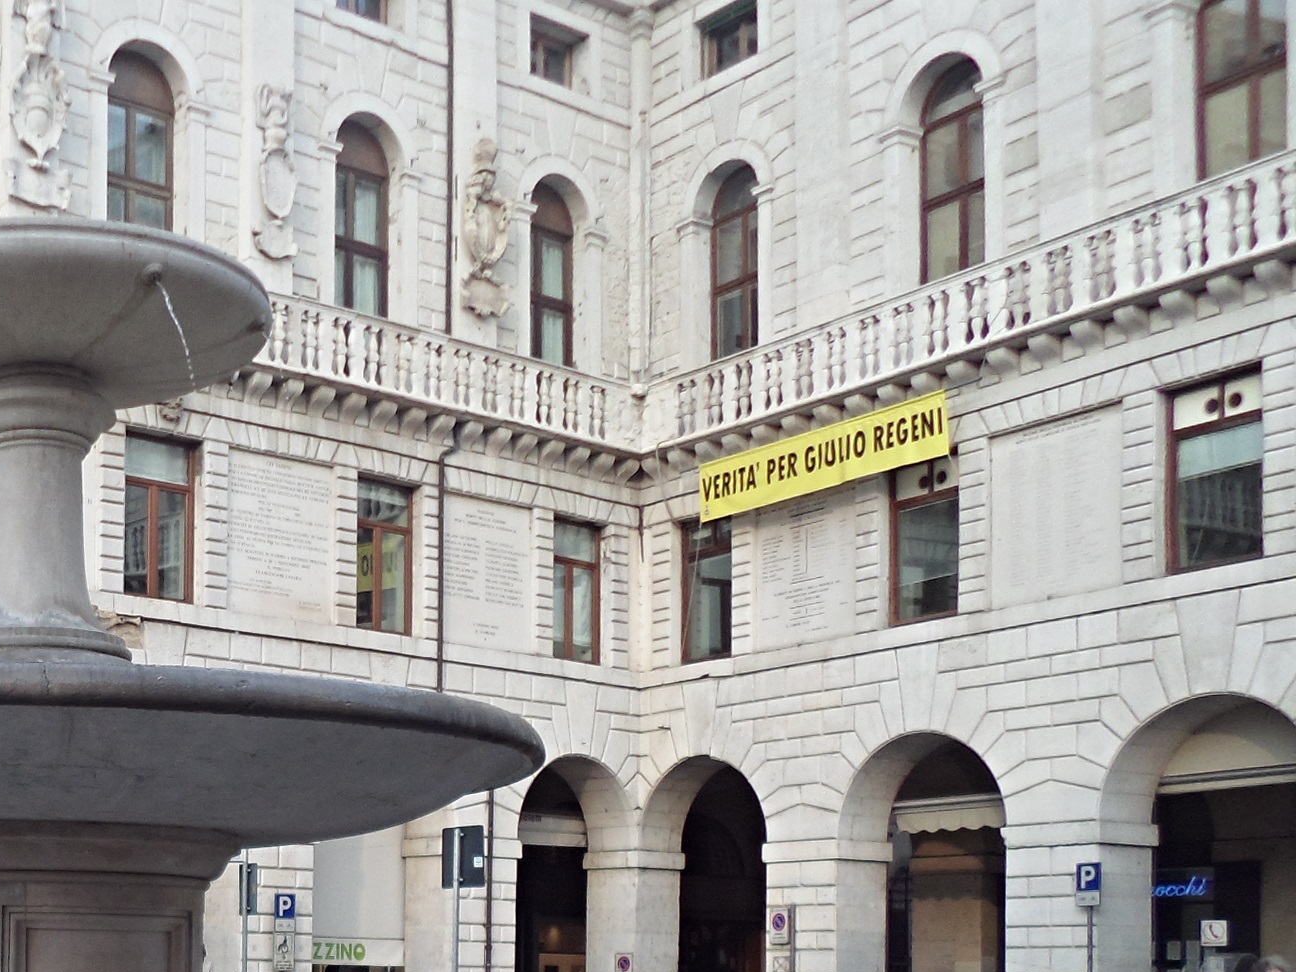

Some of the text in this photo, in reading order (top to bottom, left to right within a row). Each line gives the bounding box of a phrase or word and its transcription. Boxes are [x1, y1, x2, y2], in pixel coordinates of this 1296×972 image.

[702, 407, 944, 503] VERITA' PER GIULIO REGENI
[1080, 866, 1096, 889] P
[279, 896, 292, 917] P
